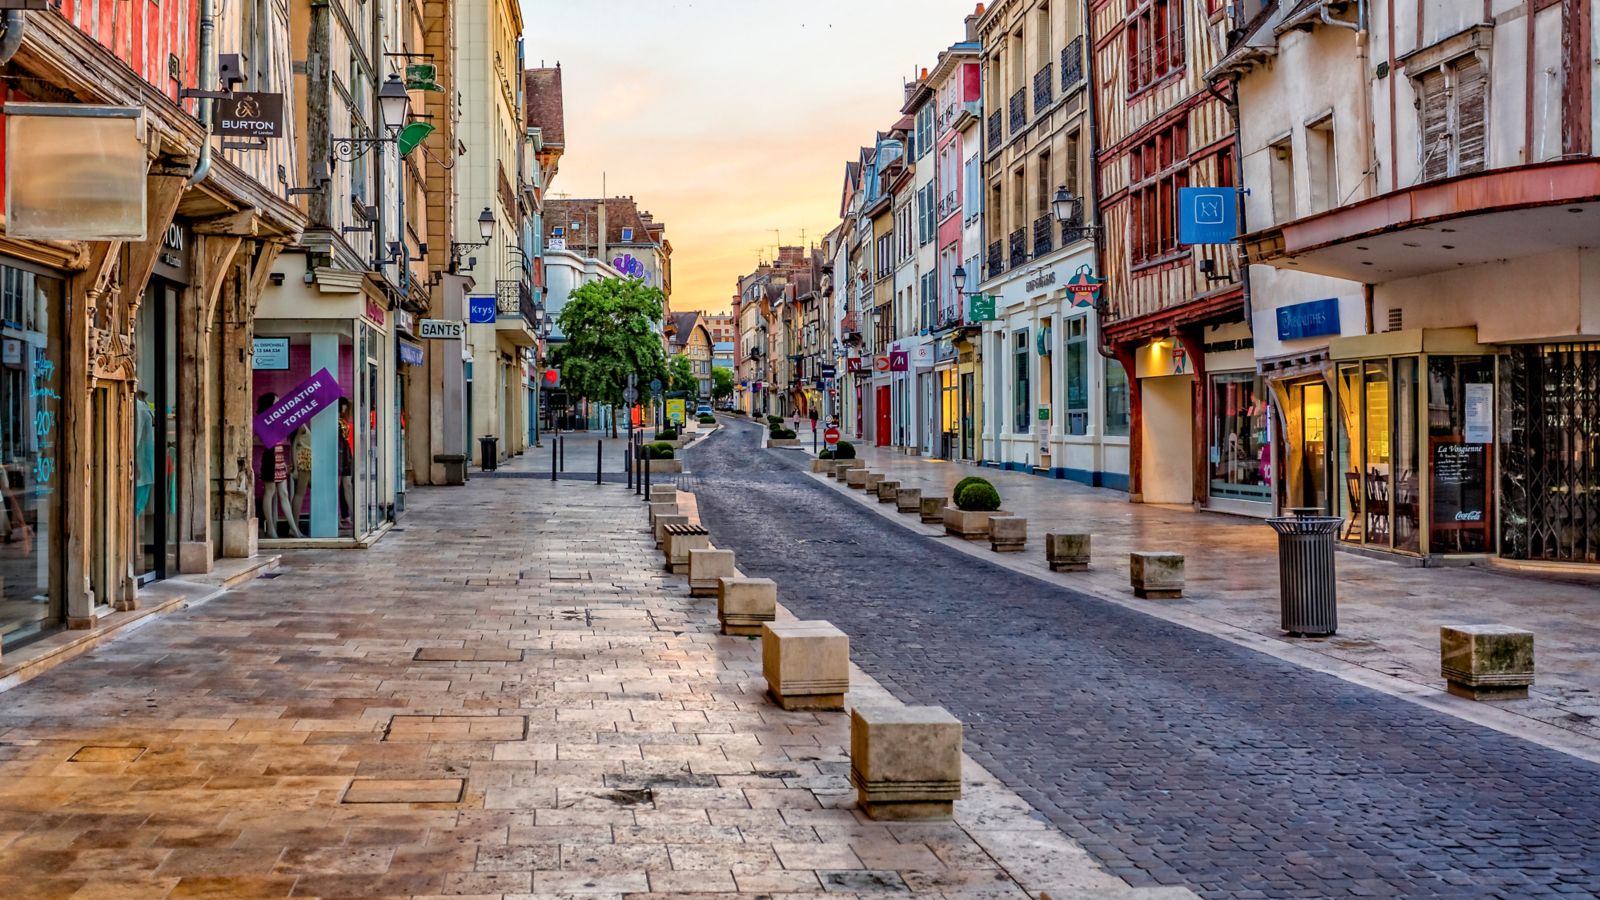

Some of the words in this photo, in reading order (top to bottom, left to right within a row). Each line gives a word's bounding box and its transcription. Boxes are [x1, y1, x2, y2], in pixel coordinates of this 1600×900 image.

[222, 120, 274, 130] BURTON
[422, 323, 461, 336] GANTS
[264, 380, 322, 425] LIQUIDATION
[283, 399, 319, 427] TOTALE
